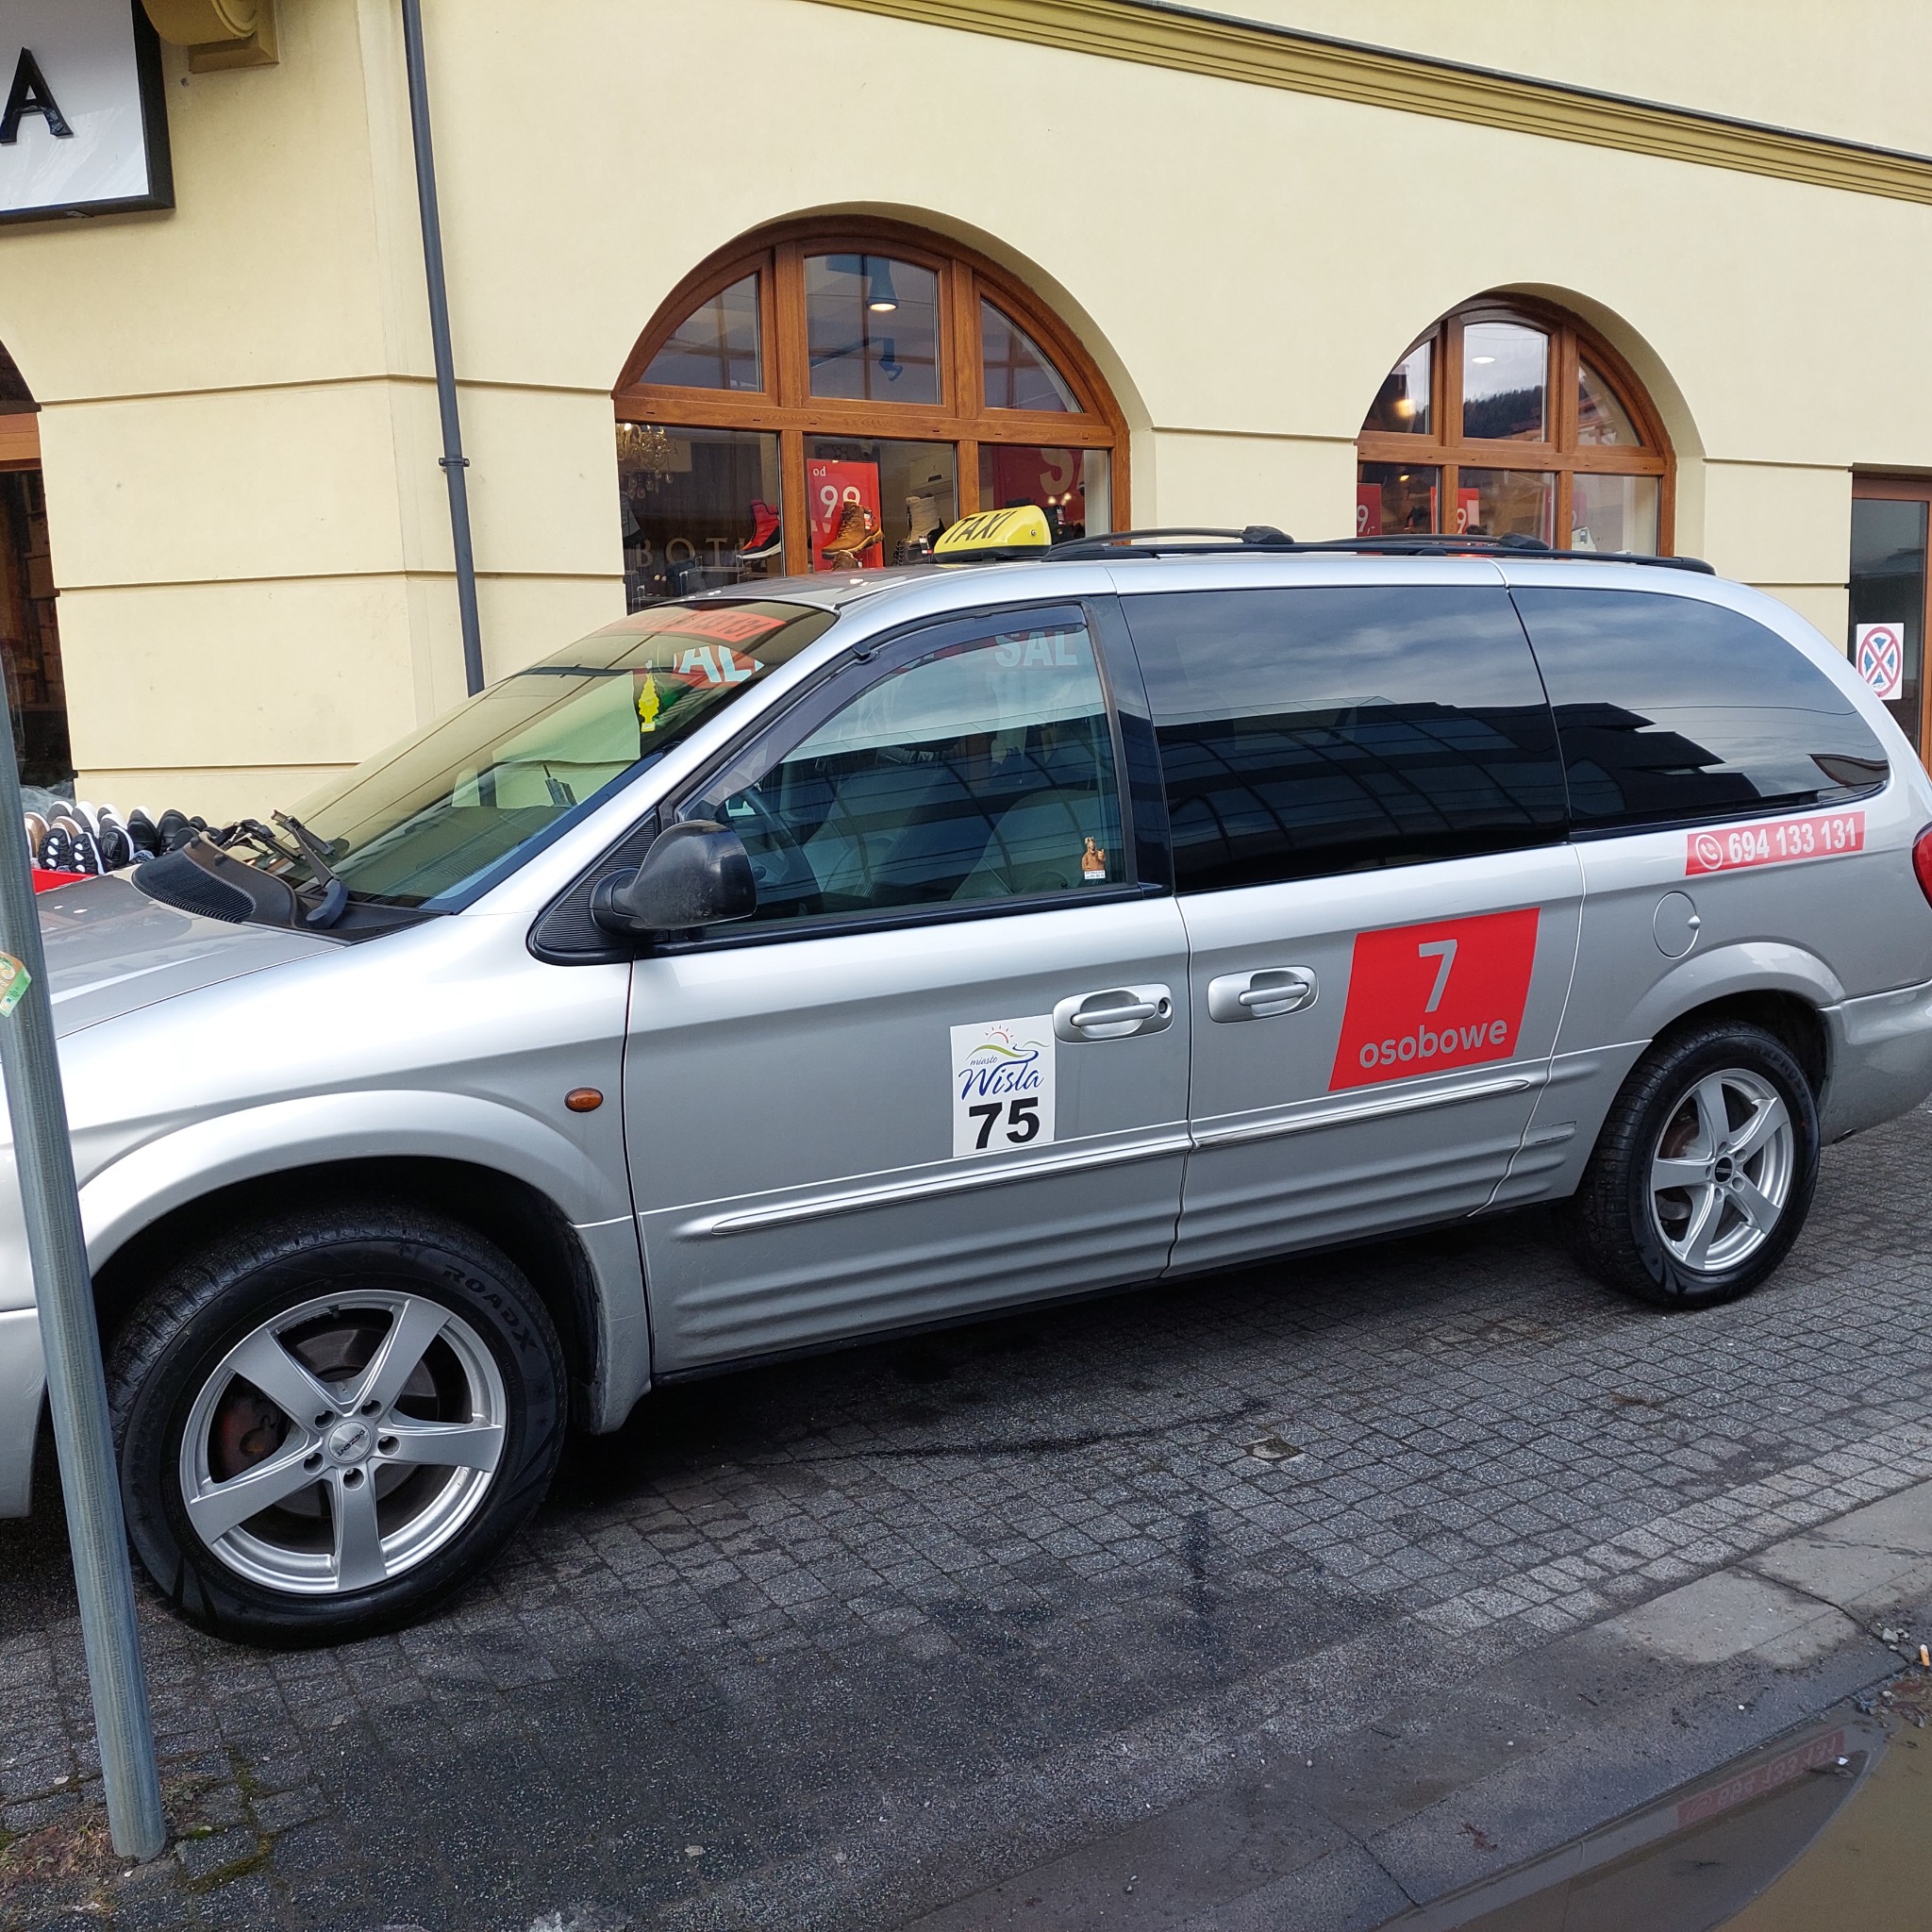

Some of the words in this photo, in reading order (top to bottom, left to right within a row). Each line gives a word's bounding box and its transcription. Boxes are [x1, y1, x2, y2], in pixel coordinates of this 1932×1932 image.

[812, 466, 826, 476] od
[943, 510, 1018, 544] TAXI
[1728, 828, 1771, 864] 694
[1775, 823, 1815, 857] 133
[1821, 817, 1857, 850] 131
[1418, 938, 1458, 1014] 7
[969, 1055, 999, 1067] miasto
[1358, 1018, 1508, 1069] osobowe
[968, 1096, 1041, 1150] 75
[441, 1263, 540, 1355] ROADX
[336, 1428, 366, 1457] DEZENT
